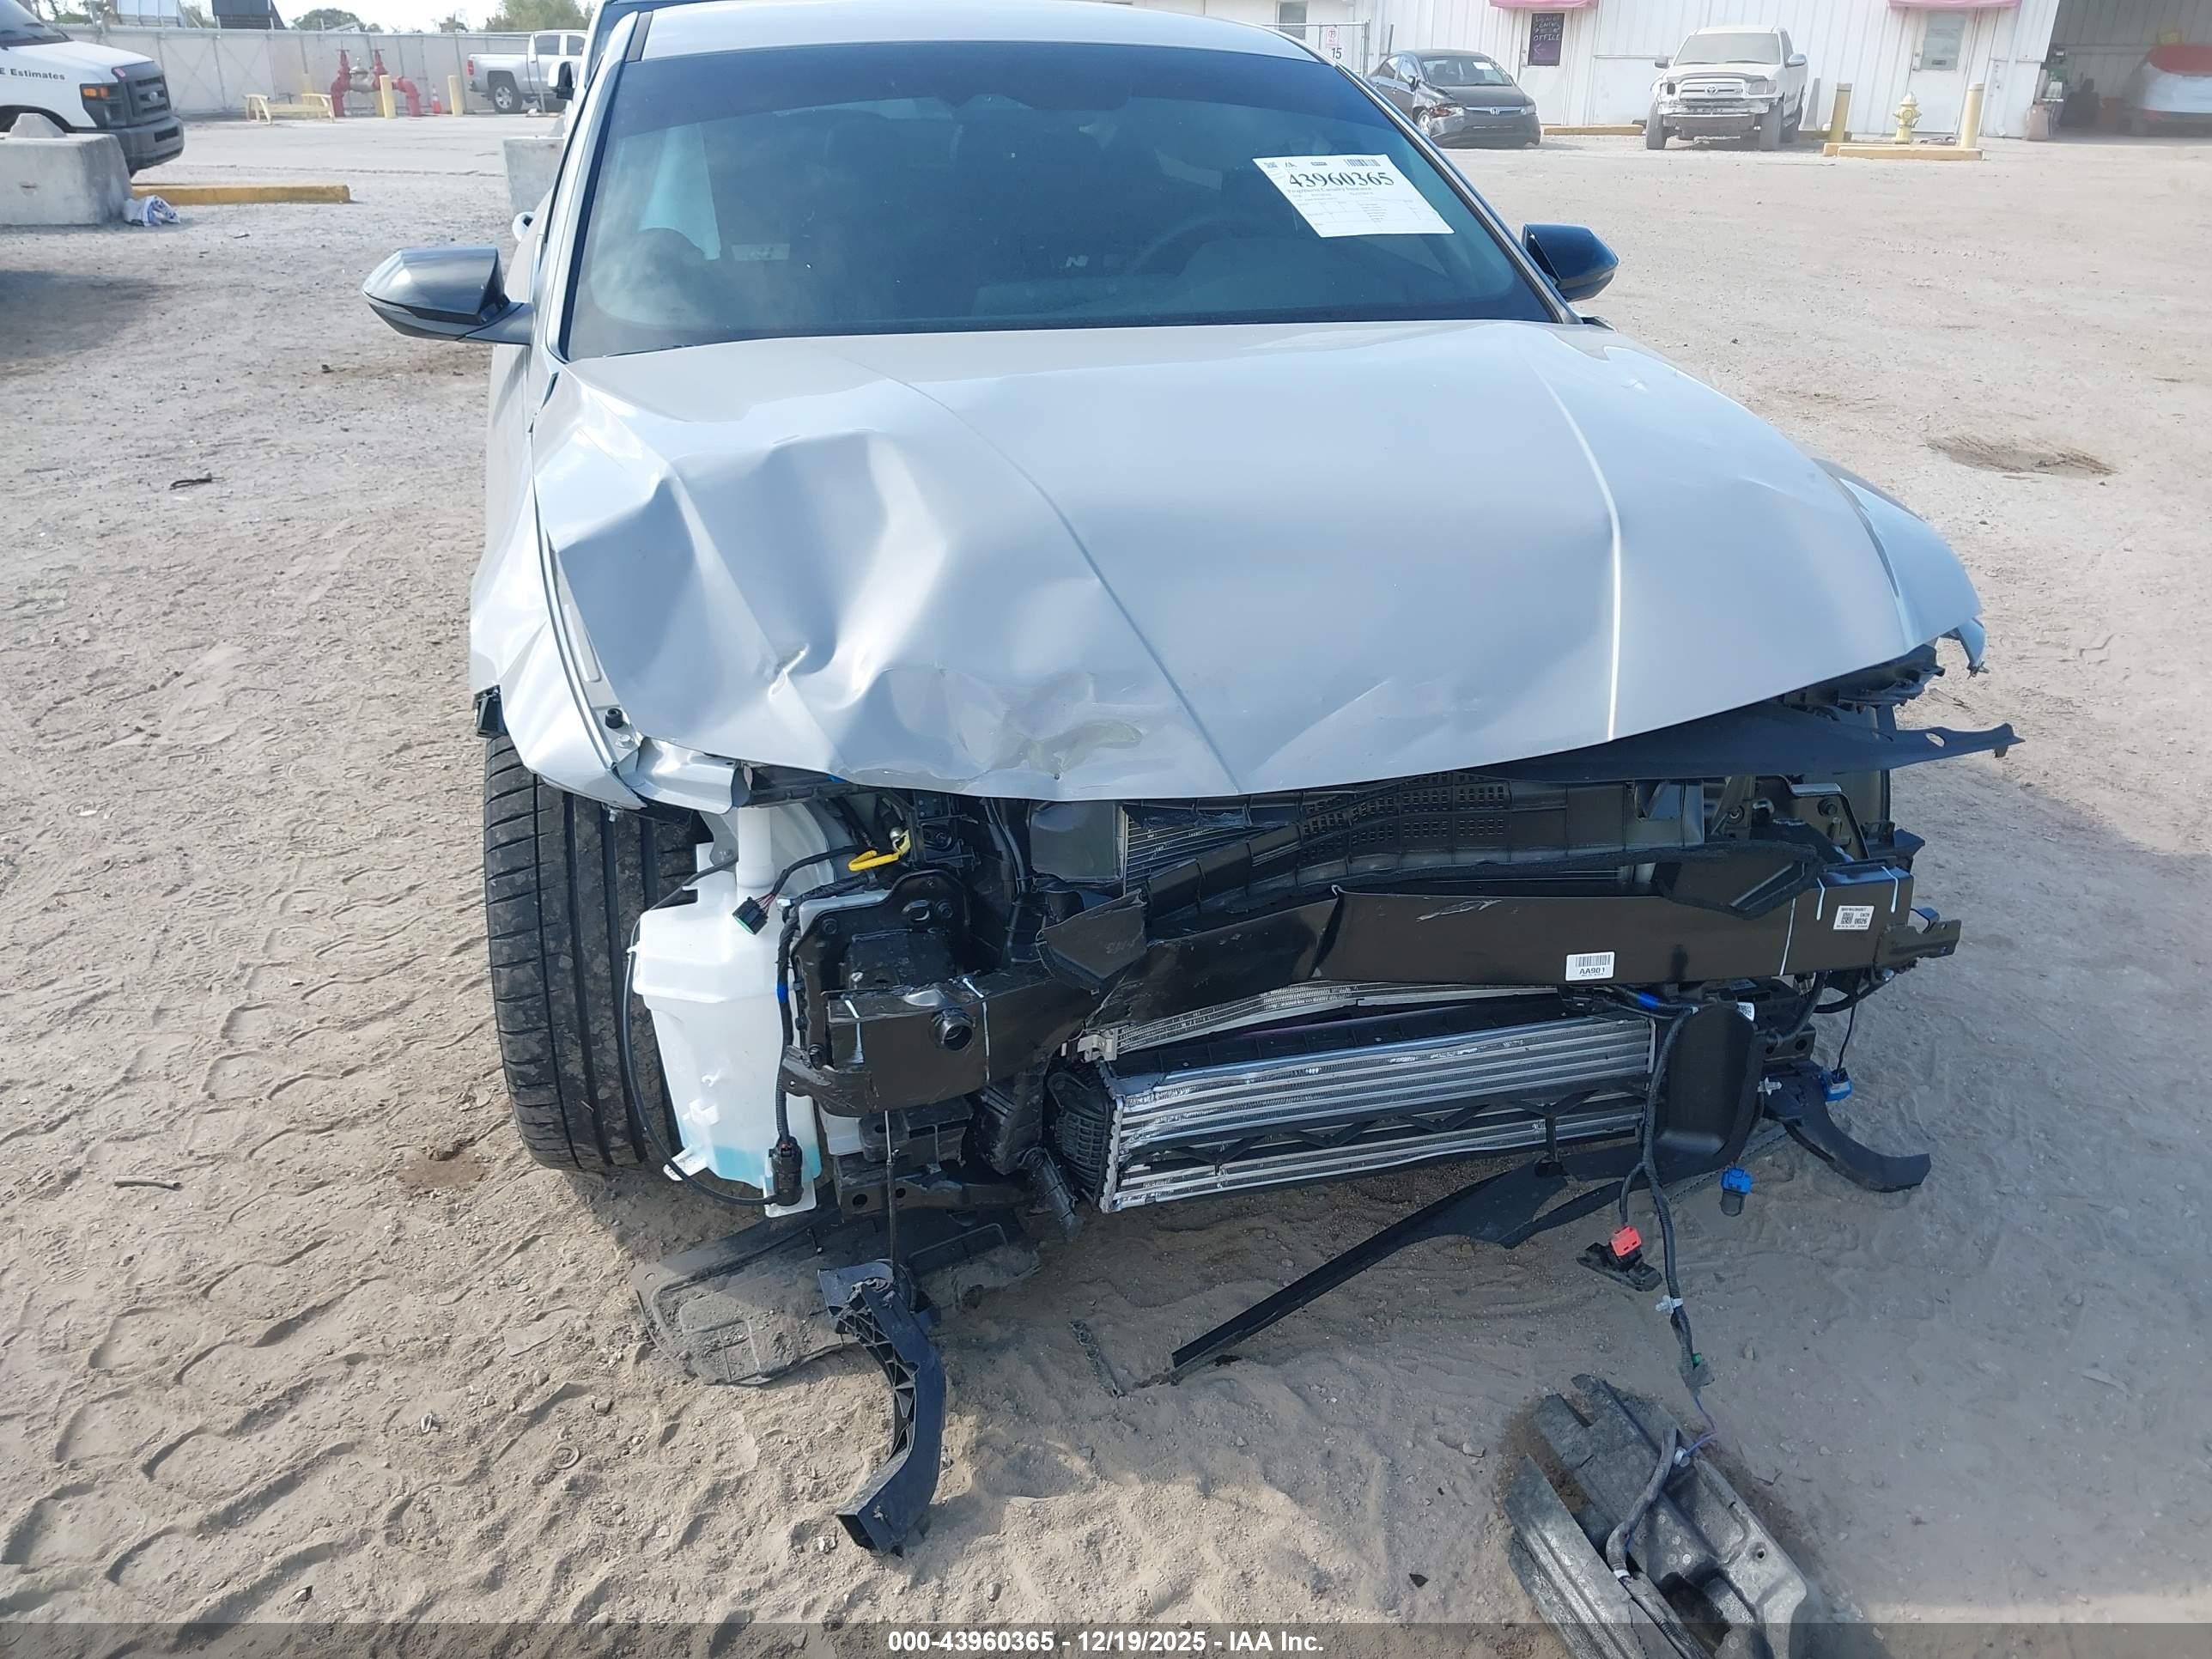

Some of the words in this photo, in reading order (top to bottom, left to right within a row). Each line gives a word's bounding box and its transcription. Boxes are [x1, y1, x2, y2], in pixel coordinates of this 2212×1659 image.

[1332, 47, 1342, 59] 15
[10, 68, 66, 80] Estimates
[1289, 172, 1395, 187] 43960365
